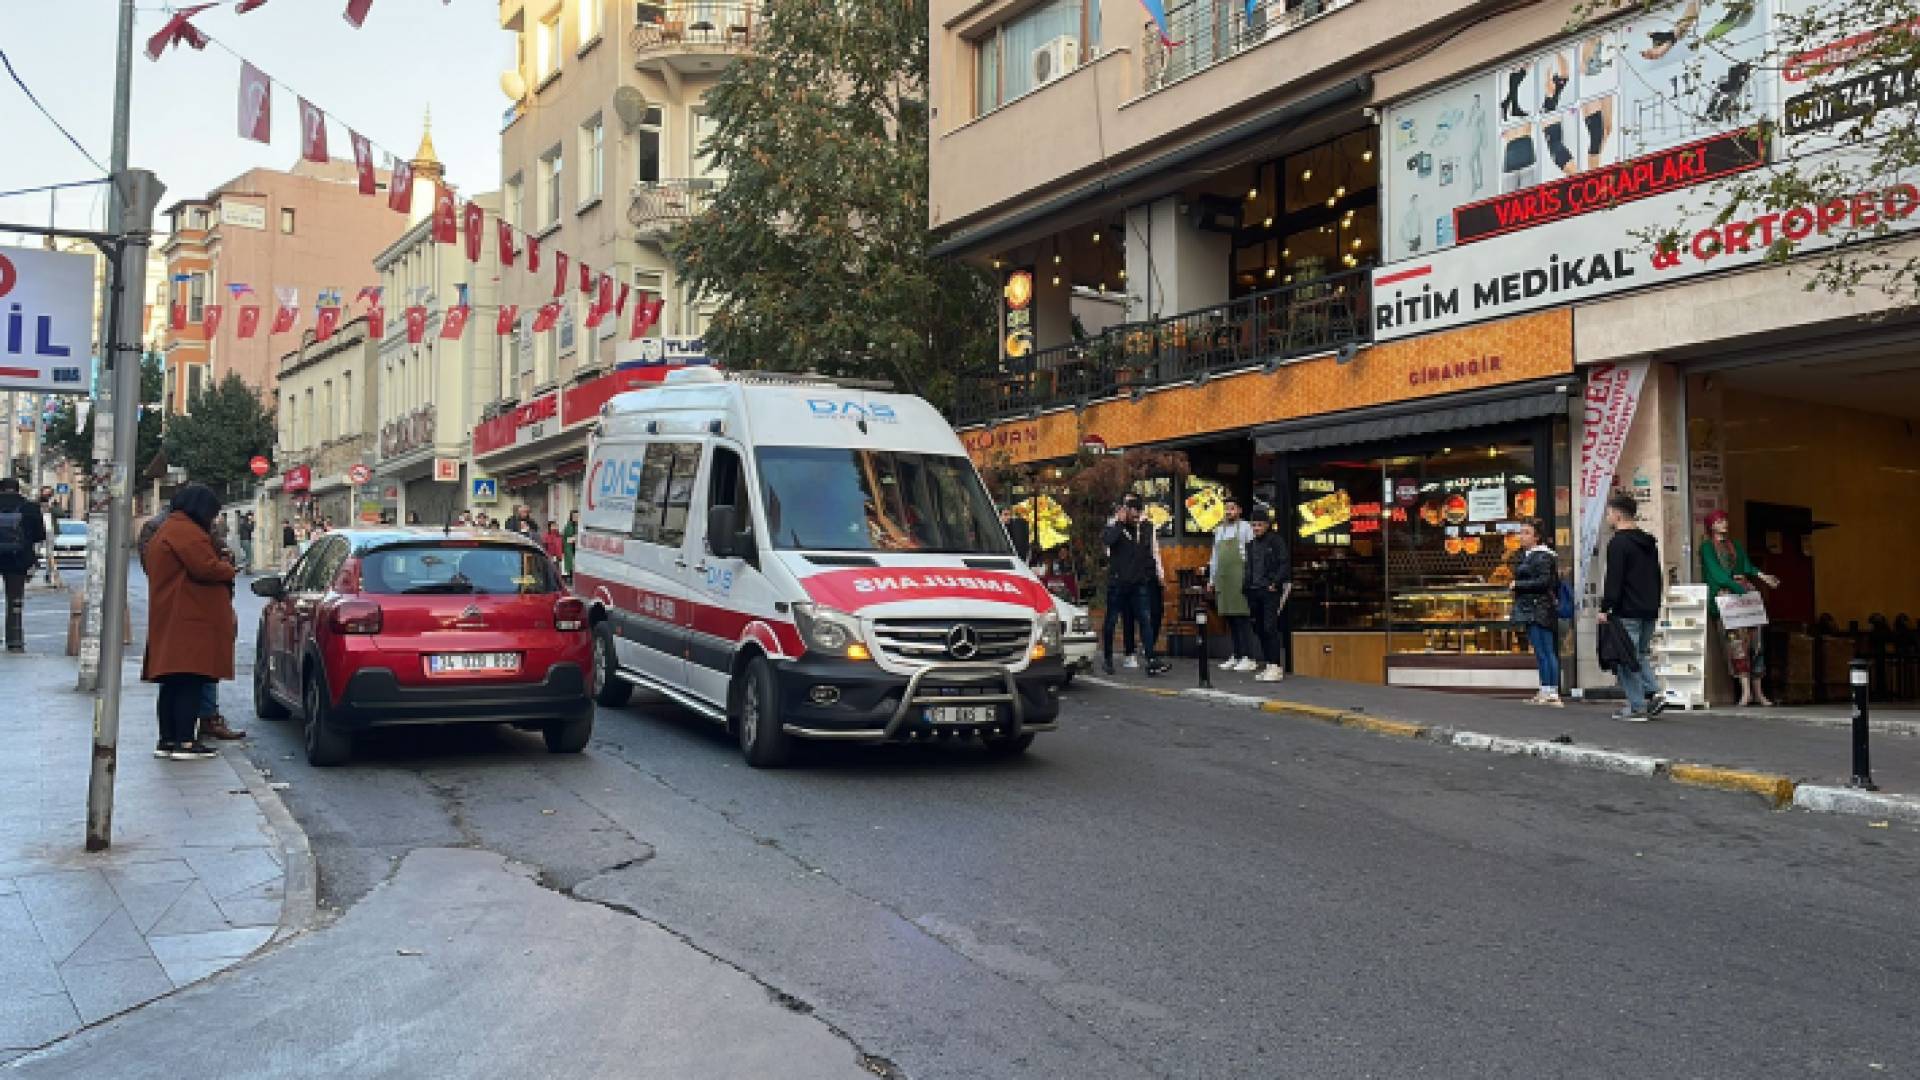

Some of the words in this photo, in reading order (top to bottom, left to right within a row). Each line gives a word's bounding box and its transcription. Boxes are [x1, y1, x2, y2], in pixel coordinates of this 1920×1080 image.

[1568, 147, 1707, 212] ÇORAPLARI
[1376, 282, 1459, 330] RİTİM
[1474, 248, 1635, 309] MEDİKAL
[807, 399, 895, 417] DAS
[1587, 464, 1604, 497] DRY
[1596, 369, 1630, 459] CLEANING
